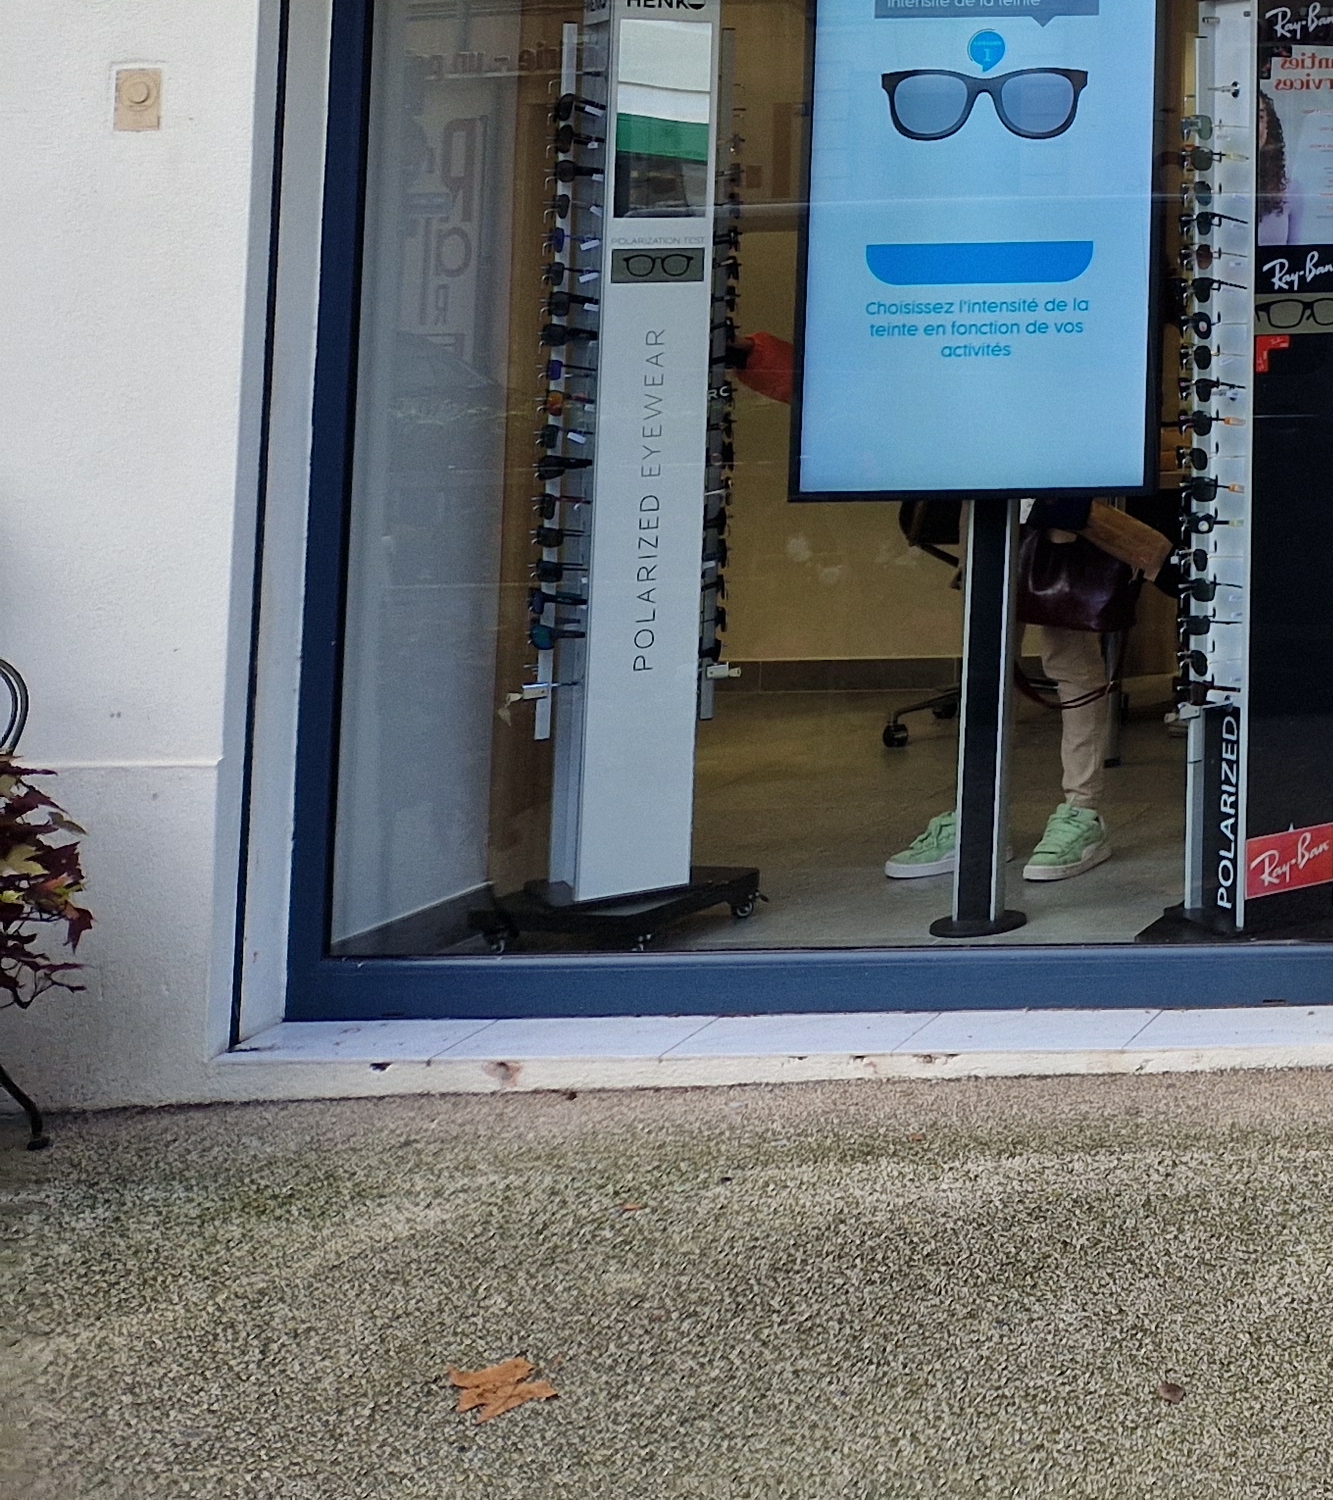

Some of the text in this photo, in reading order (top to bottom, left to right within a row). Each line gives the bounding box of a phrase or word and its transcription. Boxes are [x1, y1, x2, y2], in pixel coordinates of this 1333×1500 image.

[684, 235, 705, 244] TEST
[865, 297, 1090, 316] Choisissez l'intensité de la
[869, 319, 1084, 337] teinte en fonction de vos
[940, 341, 1012, 358] activités
[632, 327, 666, 673] POLARIZED EYEWEAR
[1215, 715, 1238, 909] POLARIZED
[1251, 831, 1330, 887] Ray-Ban
